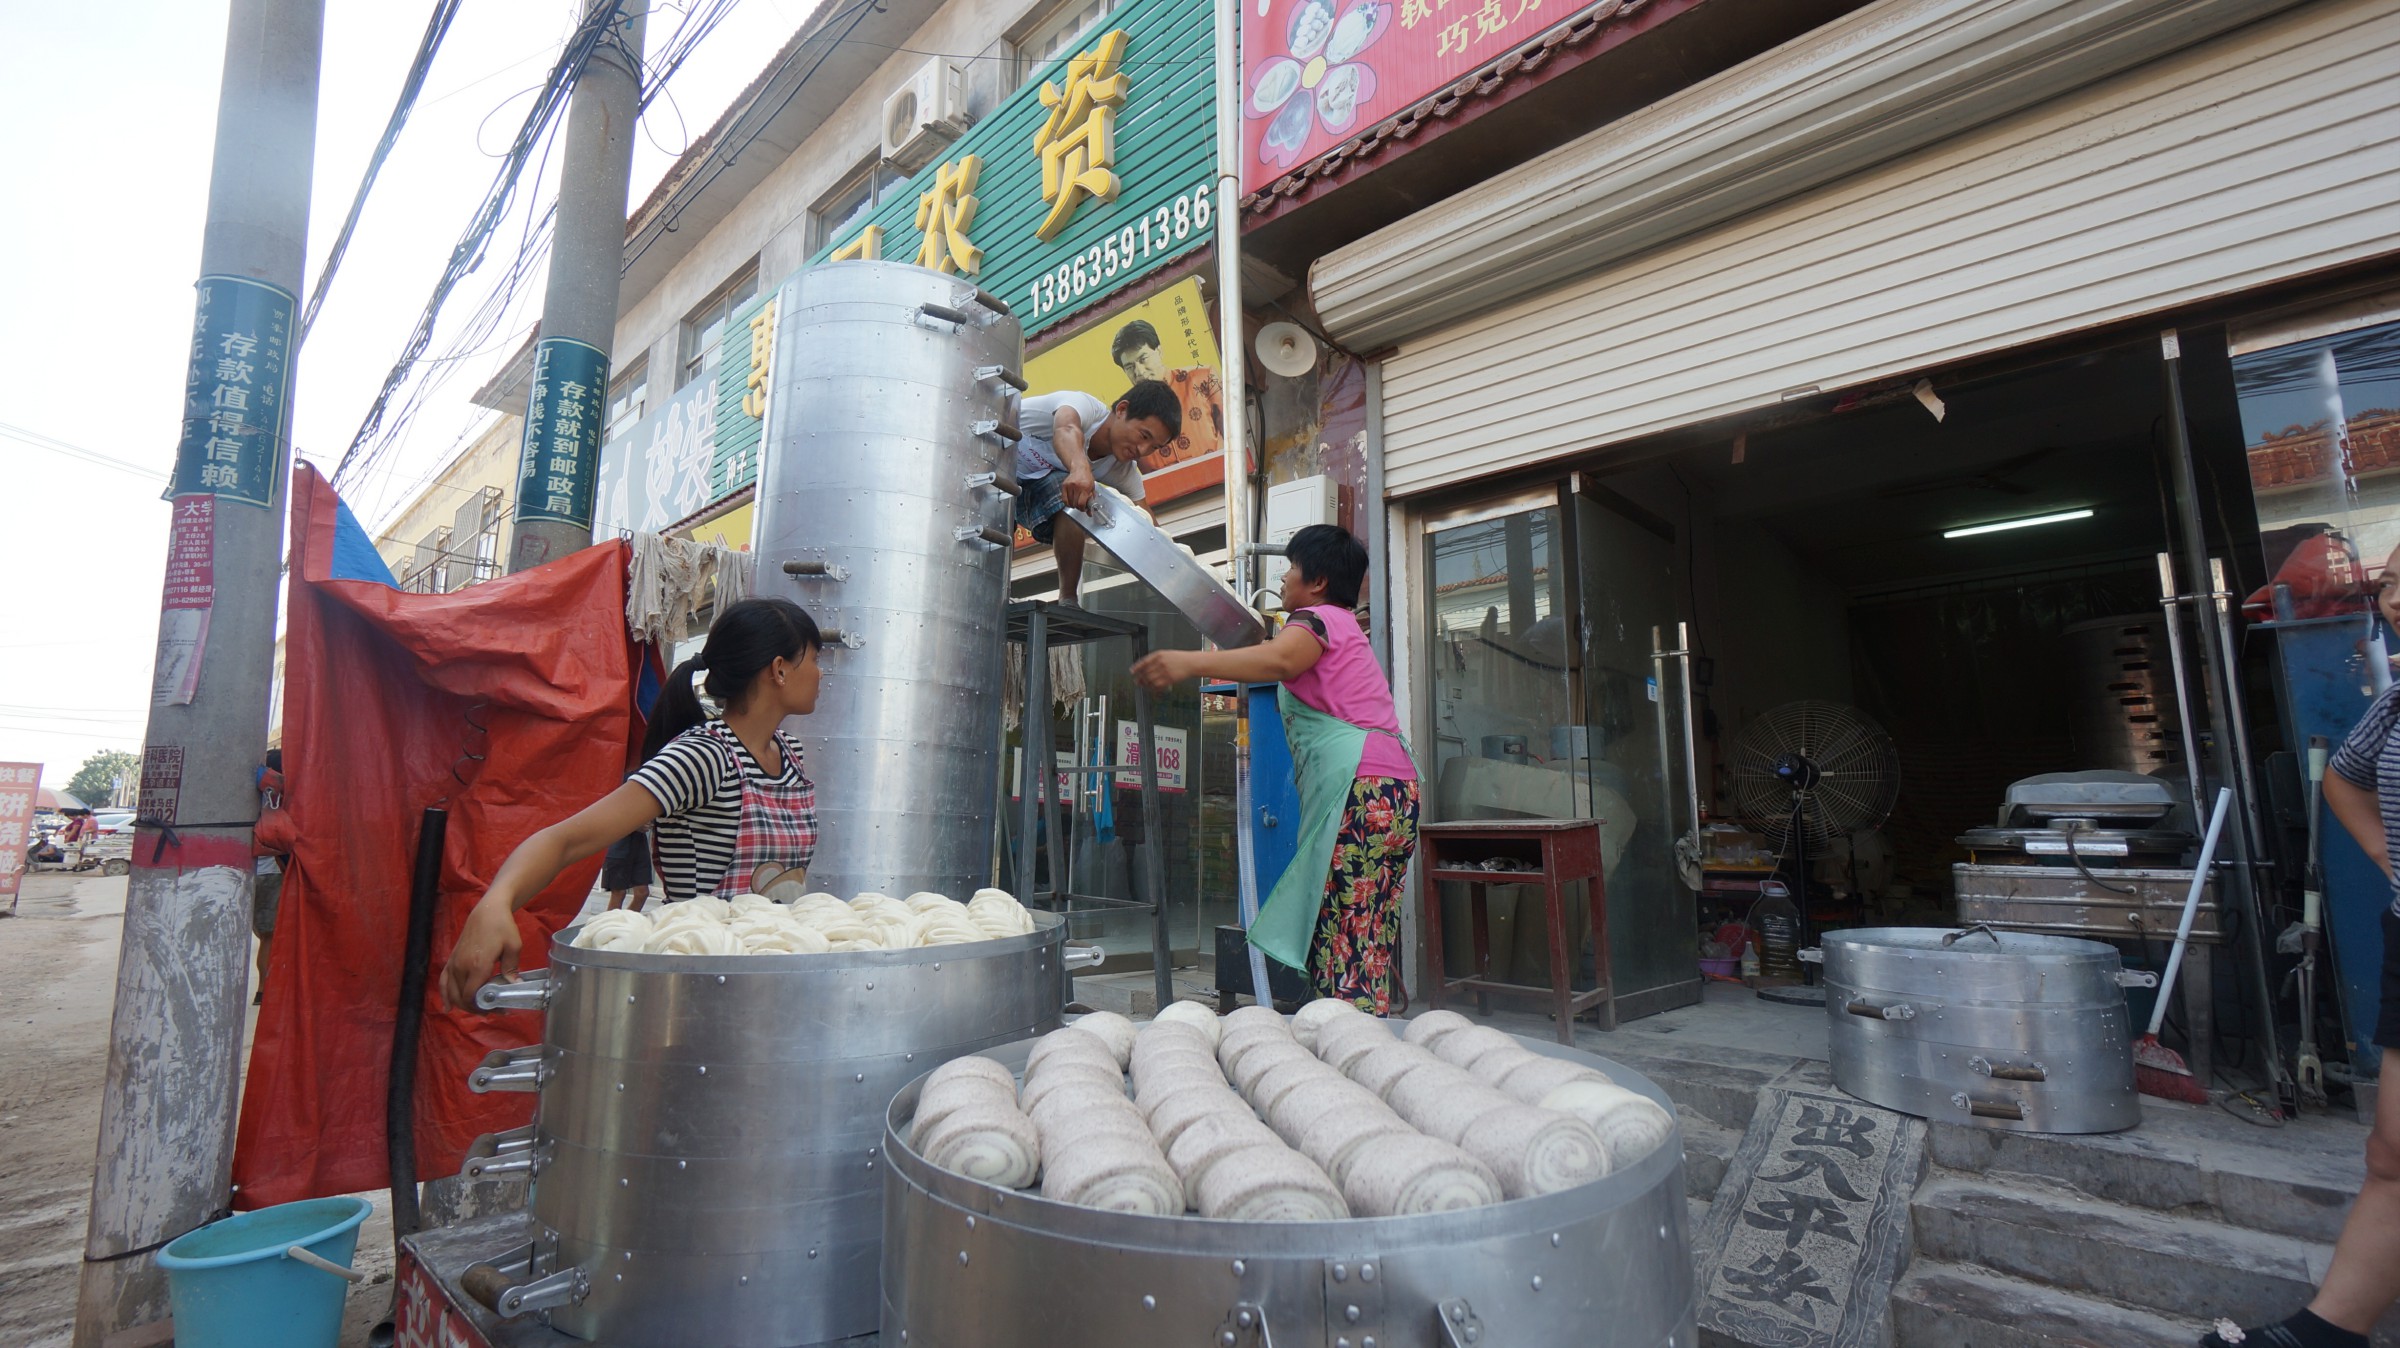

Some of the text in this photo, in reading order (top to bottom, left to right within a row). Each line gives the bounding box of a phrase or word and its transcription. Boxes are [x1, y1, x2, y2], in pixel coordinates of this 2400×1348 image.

[1030, 184, 1211, 318] 13863591386
[1174, 295, 1204, 370] 品牌形象代言人
[199, 331, 259, 490] 存款值得信赖
[544, 380, 587, 515] 存款就到邮政局
[1720, 1103, 1878, 1327] 出入平安
